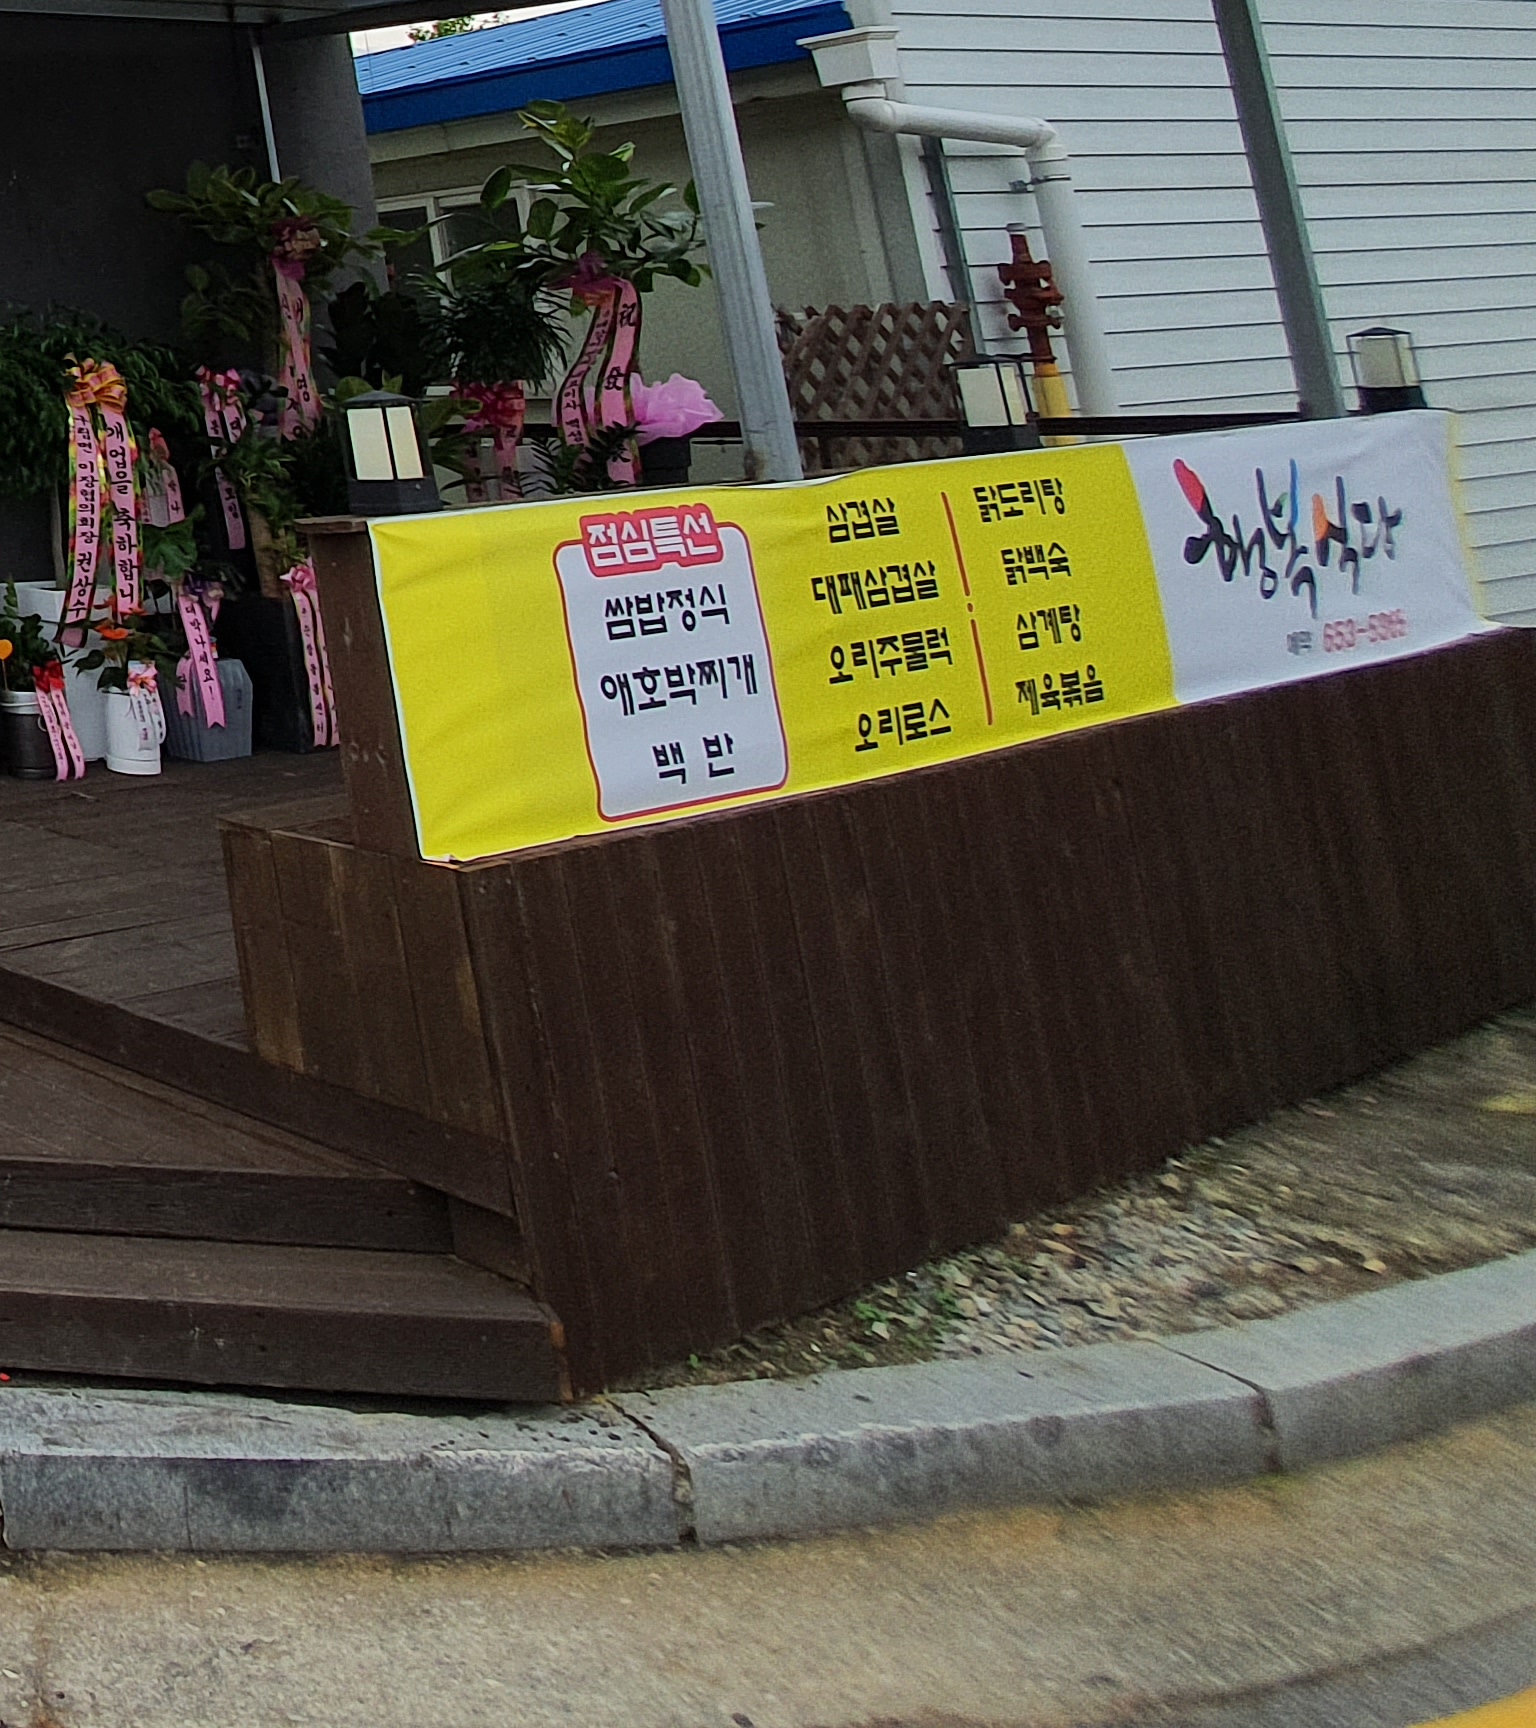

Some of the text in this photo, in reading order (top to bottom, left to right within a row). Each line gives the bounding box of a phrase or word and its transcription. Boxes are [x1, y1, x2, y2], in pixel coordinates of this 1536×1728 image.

[826, 498, 900, 543] 삼겹살
[973, 478, 1065, 522] 닭도리탕
[114, 507, 137, 605] 축하합니
[587, 512, 719, 568] 점심특선
[1000, 542, 1072, 586] 닭백숙
[1173, 458, 1403, 619] 행복식당
[605, 583, 730, 641] 쌈밥정식
[811, 560, 939, 615] 대패삼겹살
[1016, 603, 1081, 650] 삼계탕
[829, 626, 954, 685] 오리주물럭
[600, 654, 758, 716] 애호박찌개
[1015, 664, 1105, 716] 제육볶음
[854, 698, 952, 752] 오리로스
